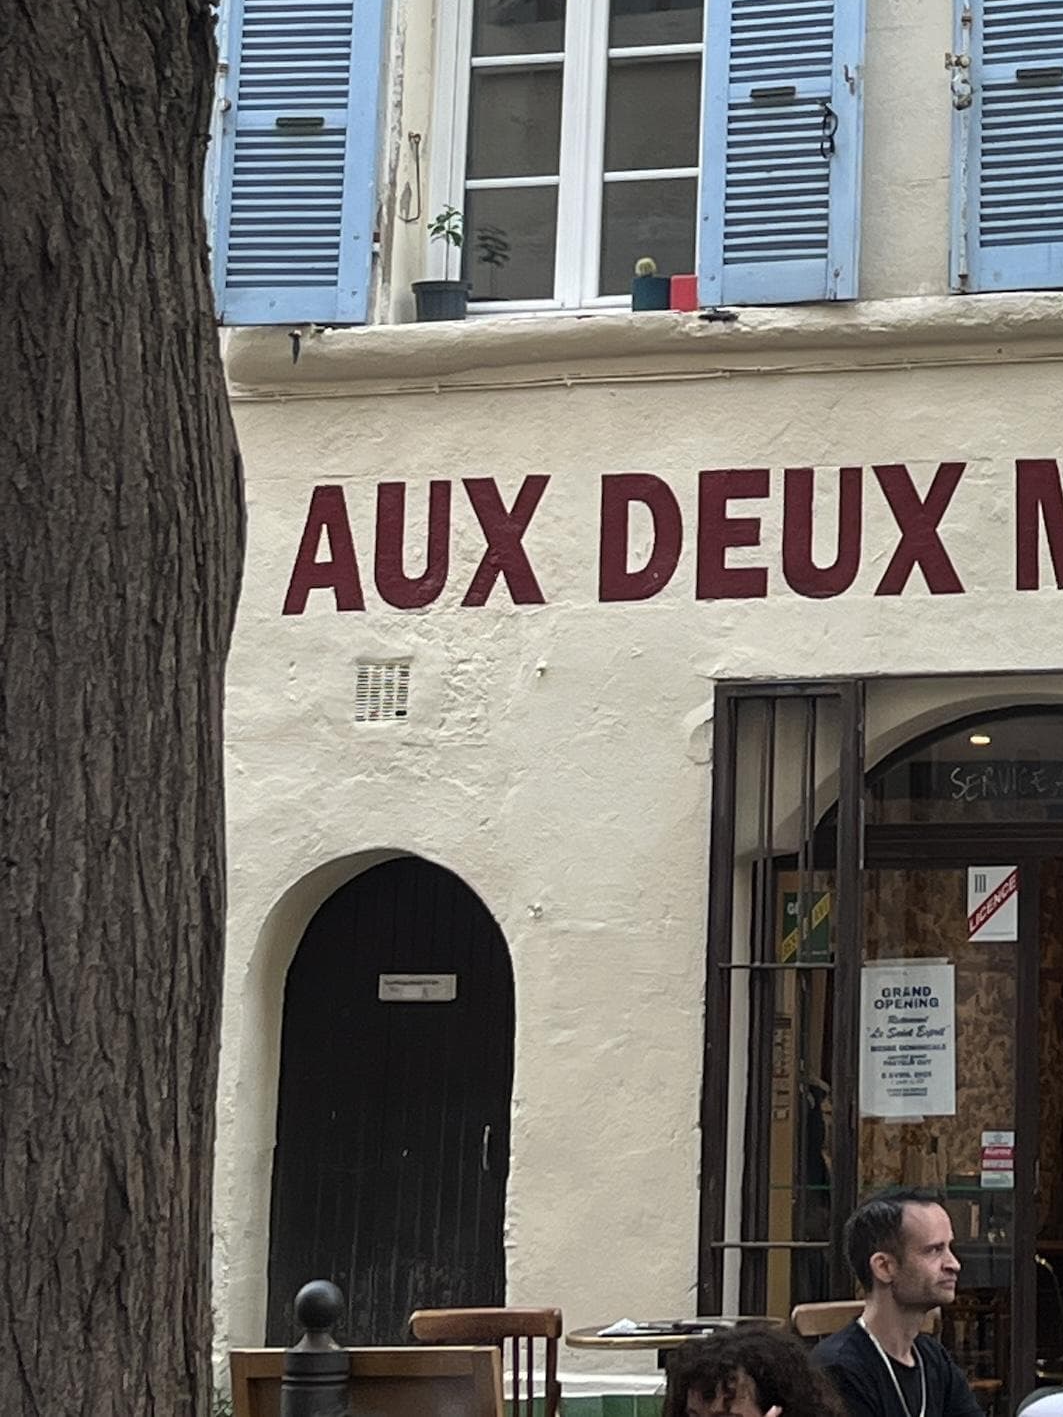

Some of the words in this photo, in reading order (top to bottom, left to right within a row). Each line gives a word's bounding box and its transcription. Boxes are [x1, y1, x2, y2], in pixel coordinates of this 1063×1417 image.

[283, 474, 551, 615] AUX
[598, 462, 967, 603] DEUX
[950, 767, 1046, 801] SERVICE
[968, 874, 1018, 932] LICENCE
[874, 997, 939, 1009] OPENING
[882, 986, 931, 997] GRAND
